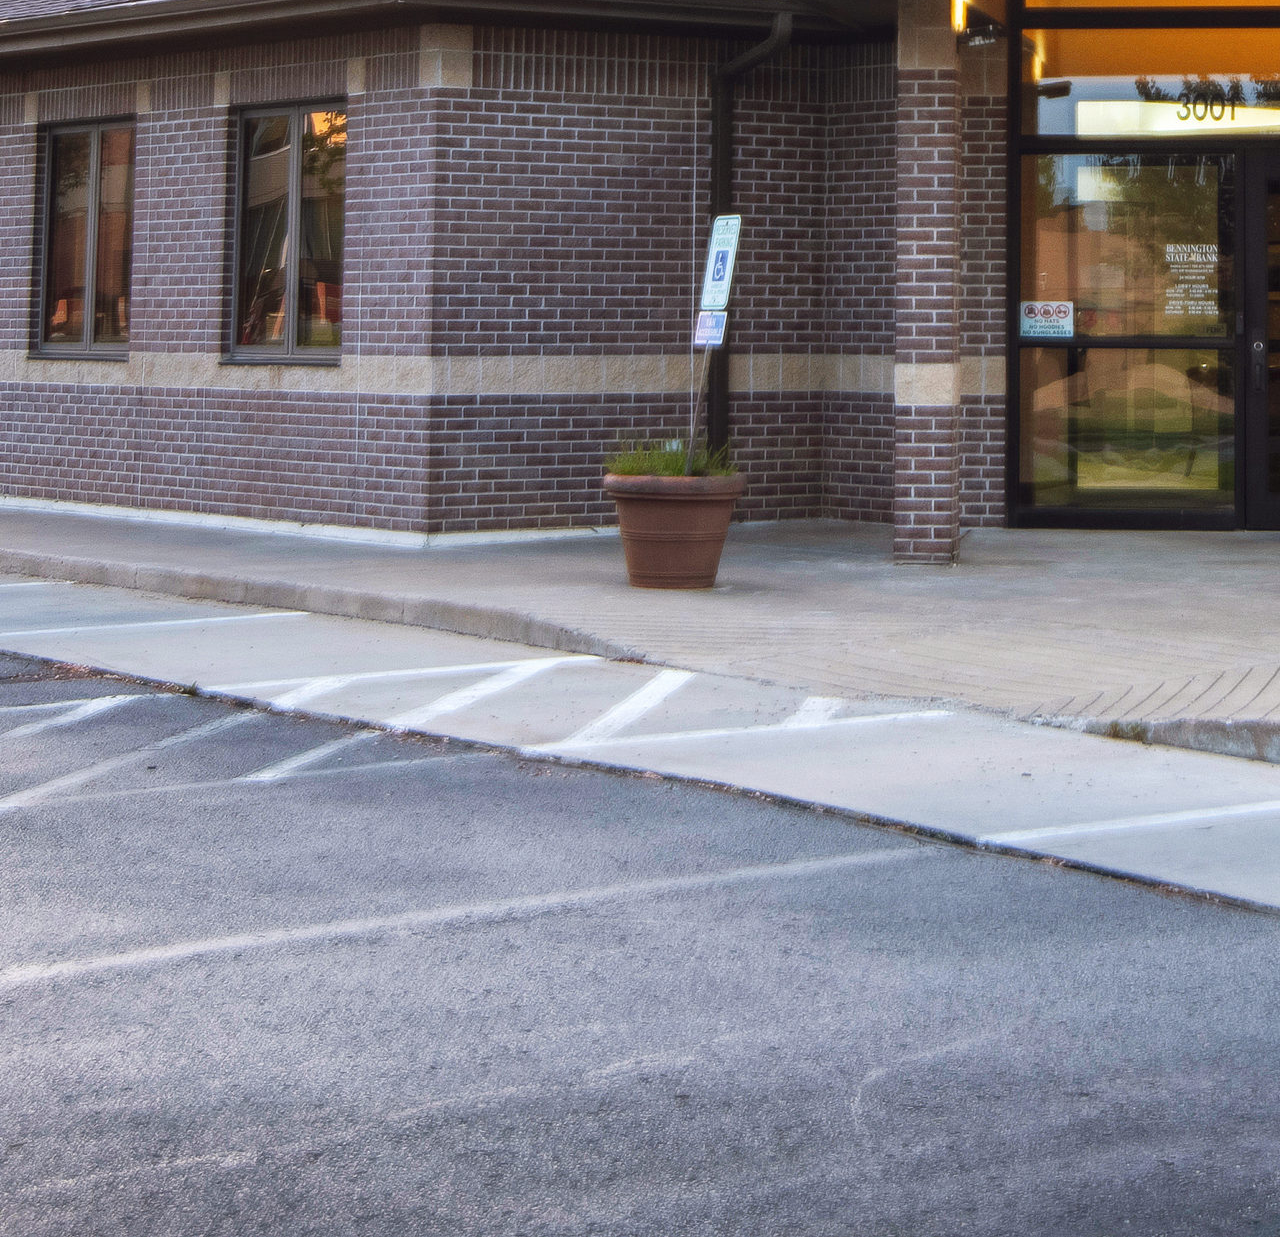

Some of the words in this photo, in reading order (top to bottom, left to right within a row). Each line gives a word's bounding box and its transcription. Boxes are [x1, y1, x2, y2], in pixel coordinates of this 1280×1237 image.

[1177, 92, 1238, 121] 3001
[1166, 243, 1218, 253] BENNINGTON
[1165, 253, 1189, 262] STATE
[1196, 253, 1218, 262] BANK
